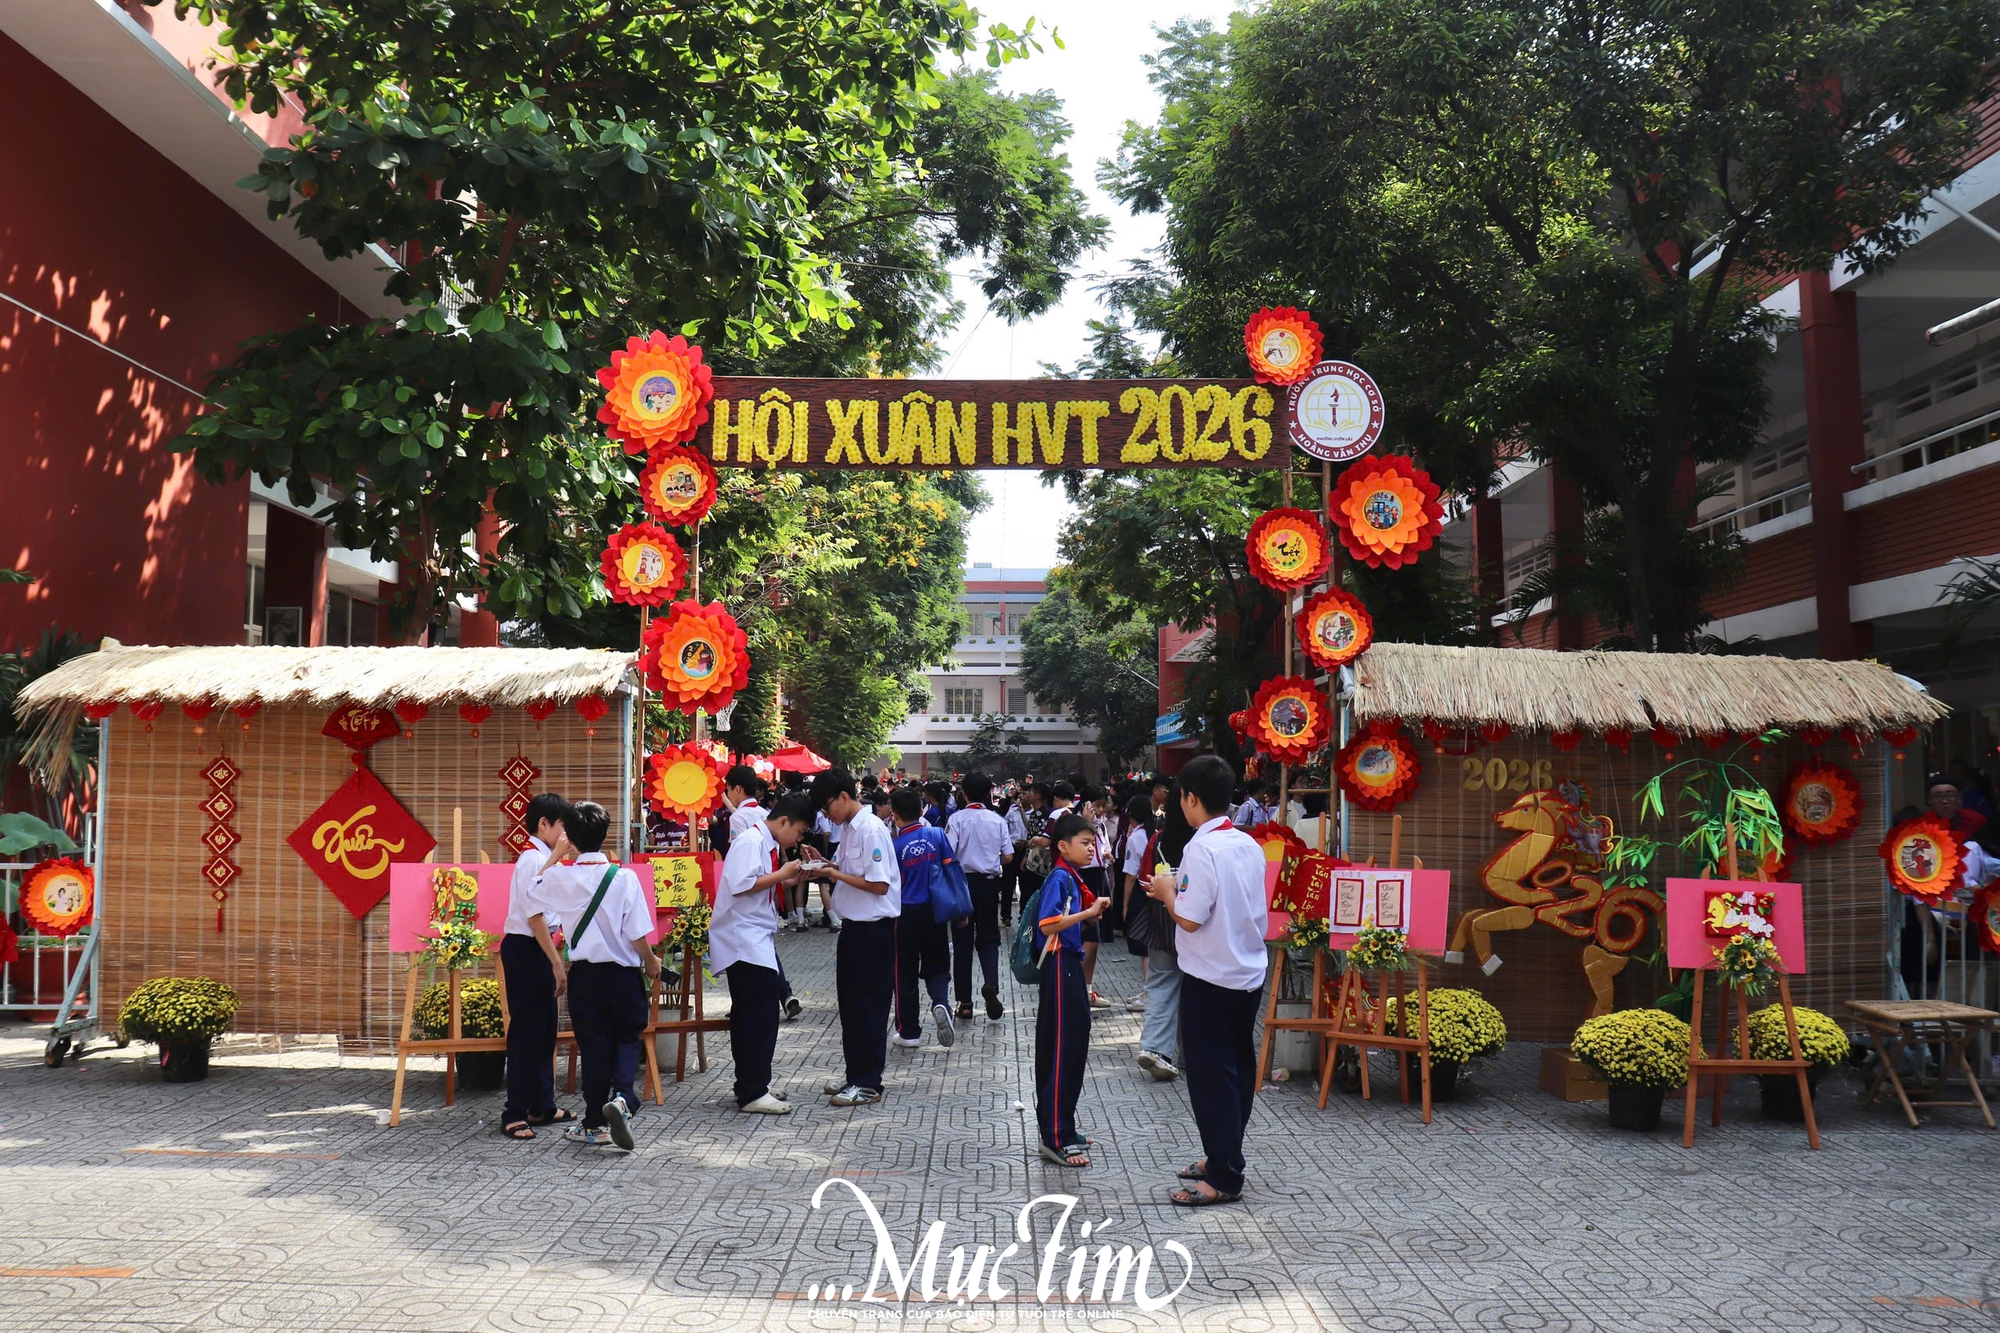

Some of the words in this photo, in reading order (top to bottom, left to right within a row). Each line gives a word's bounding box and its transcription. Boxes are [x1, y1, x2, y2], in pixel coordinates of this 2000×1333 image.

[1311, 365, 1344, 377] TRUNG
[1346, 368, 1365, 384] HỌC
[1364, 384, 1376, 397] CƠ
[1371, 399, 1382, 412] SỞ
[712, 387, 809, 470] HỘI
[825, 389, 977, 465] XUÂN
[992, 400, 1110, 465] HVT
[1119, 384, 1274, 464] 2026
[1297, 433, 1331, 457] HOÀNG
[1333, 447, 1354, 458] VĂN
[1355, 434, 1373, 451] THỤ
[1462, 757, 1553, 791] 2026
